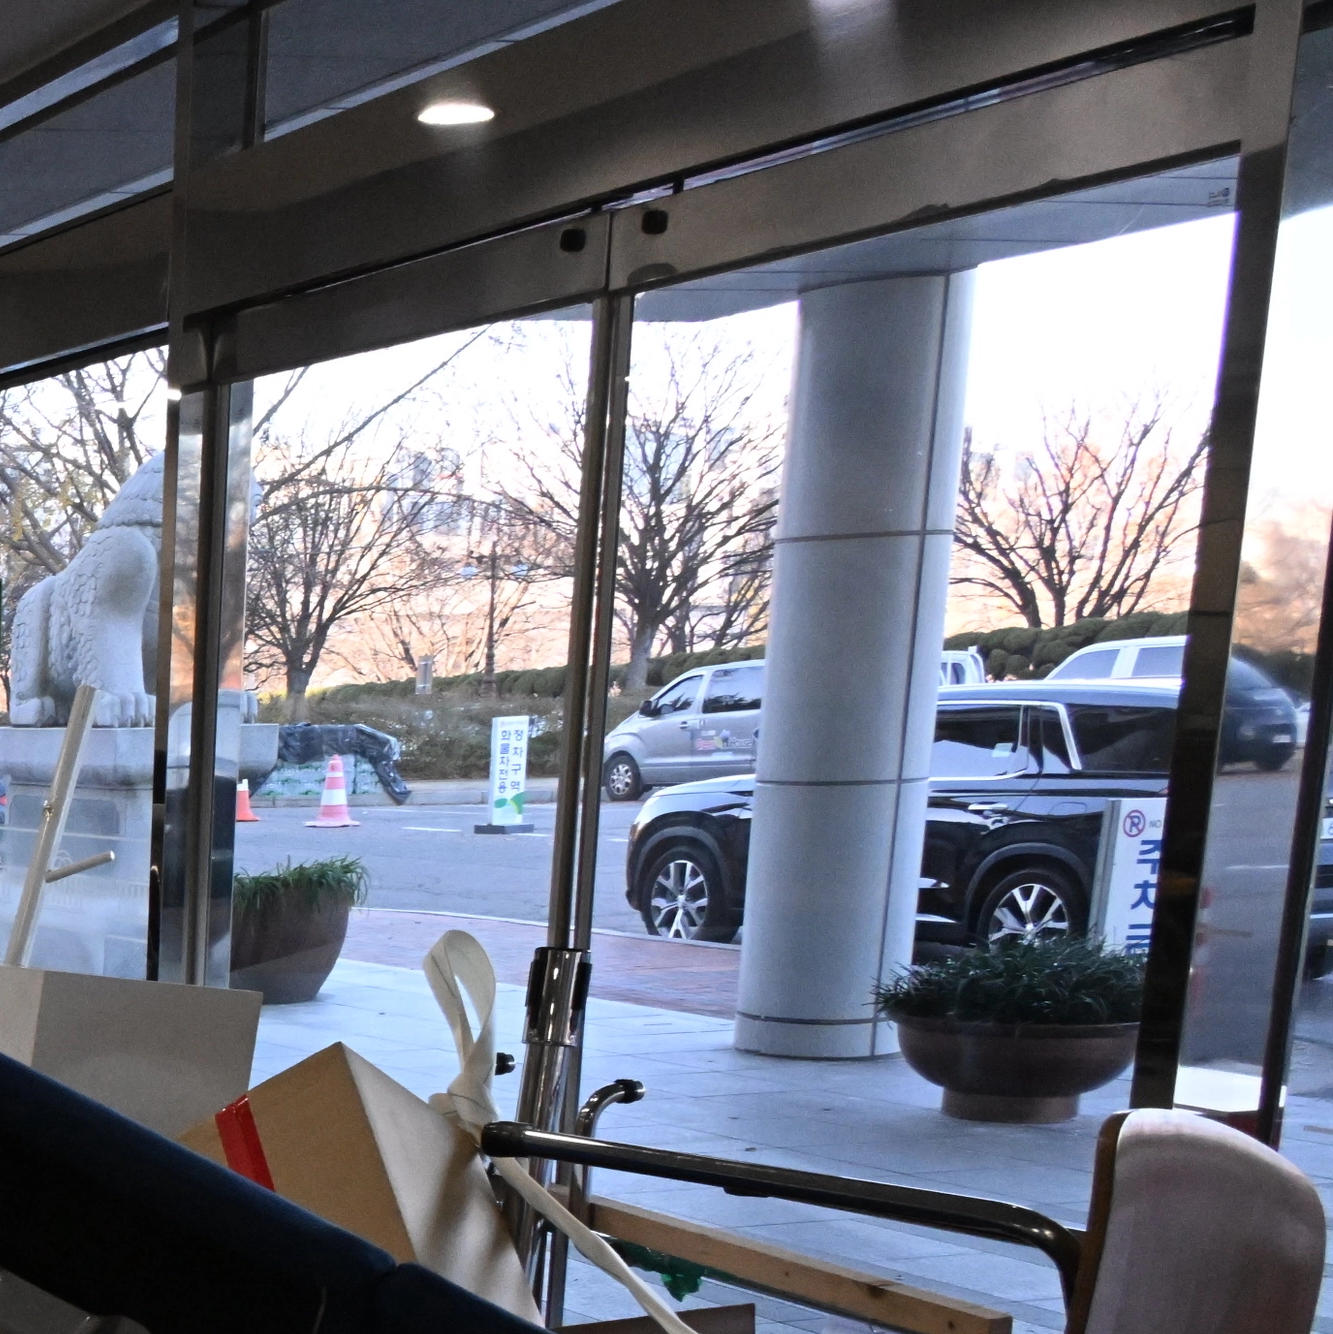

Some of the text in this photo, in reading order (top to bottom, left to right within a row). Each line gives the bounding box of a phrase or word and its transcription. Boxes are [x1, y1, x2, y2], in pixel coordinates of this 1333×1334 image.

[498, 729, 511, 794] 화물차전용
[510, 729, 524, 792] 정차구역
[1149, 819, 1162, 829] NO
